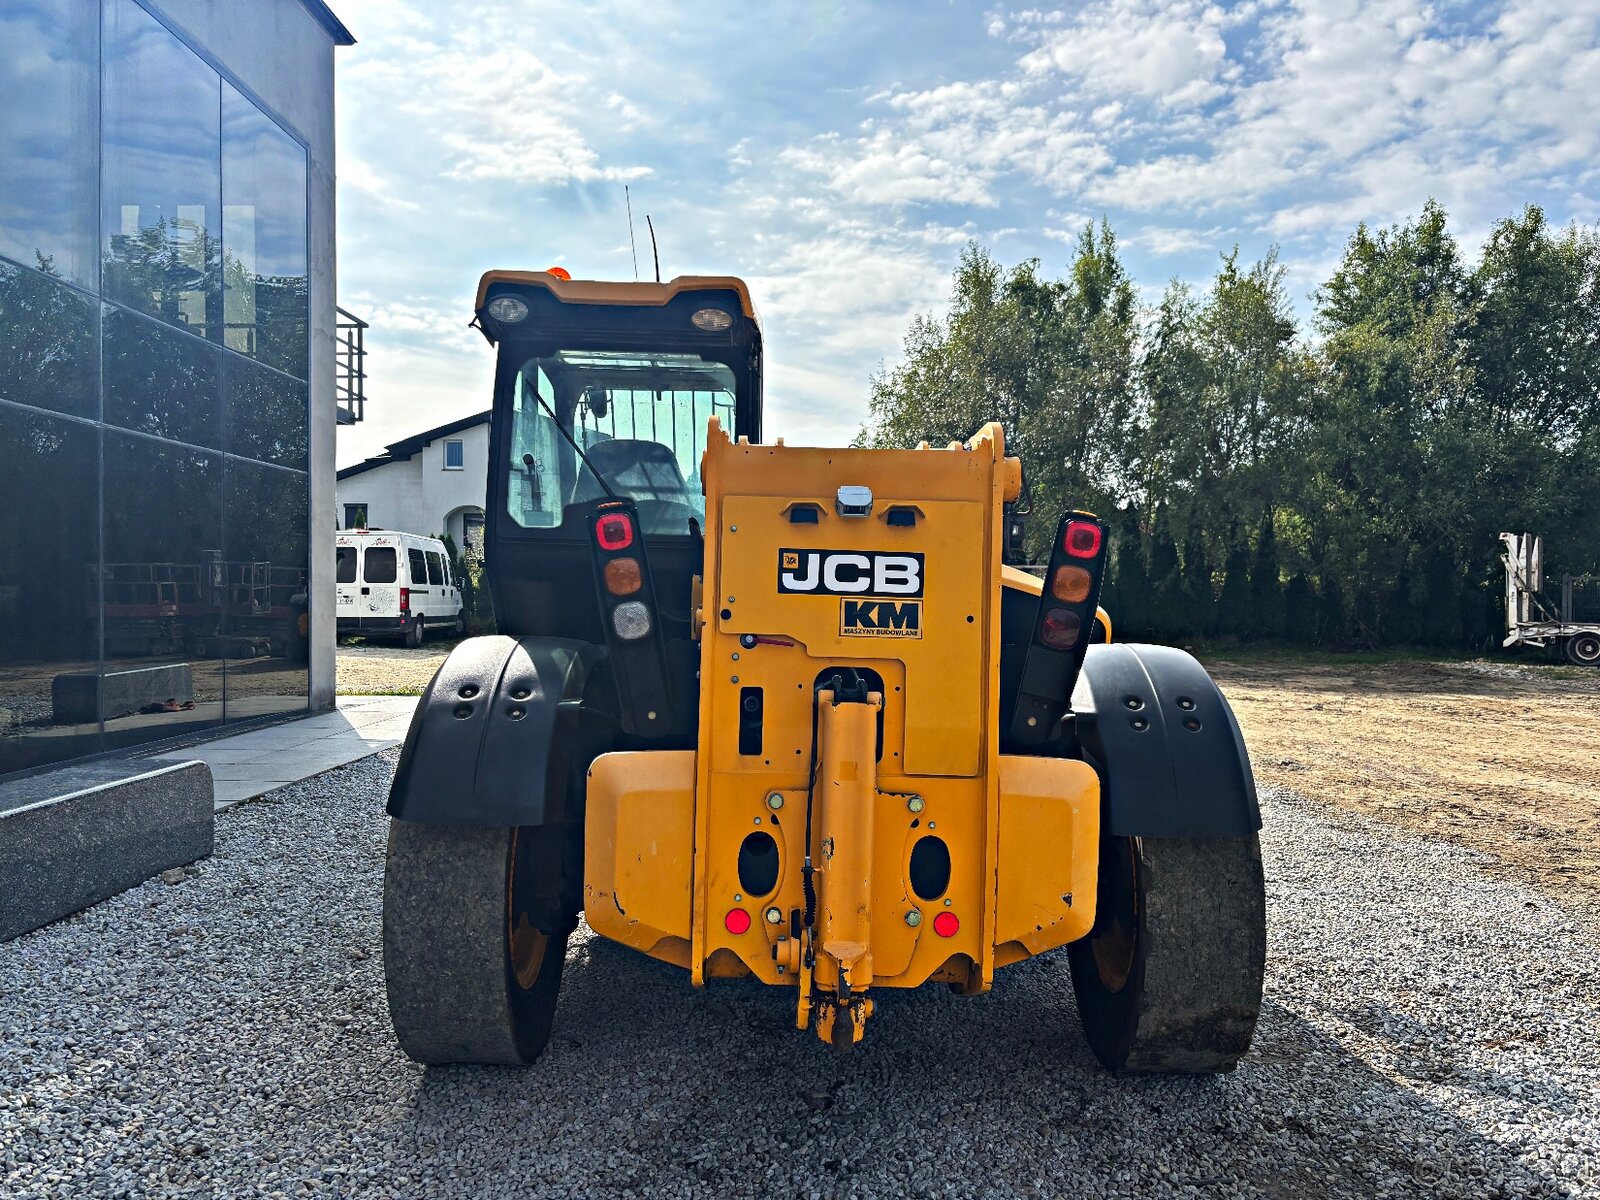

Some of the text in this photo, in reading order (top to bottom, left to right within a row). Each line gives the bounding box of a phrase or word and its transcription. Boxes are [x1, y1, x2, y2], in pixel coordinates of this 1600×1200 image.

[782, 553, 920, 594] JCB
[845, 601, 919, 629] KM
[876, 629, 918, 637] BUDOWLANE
